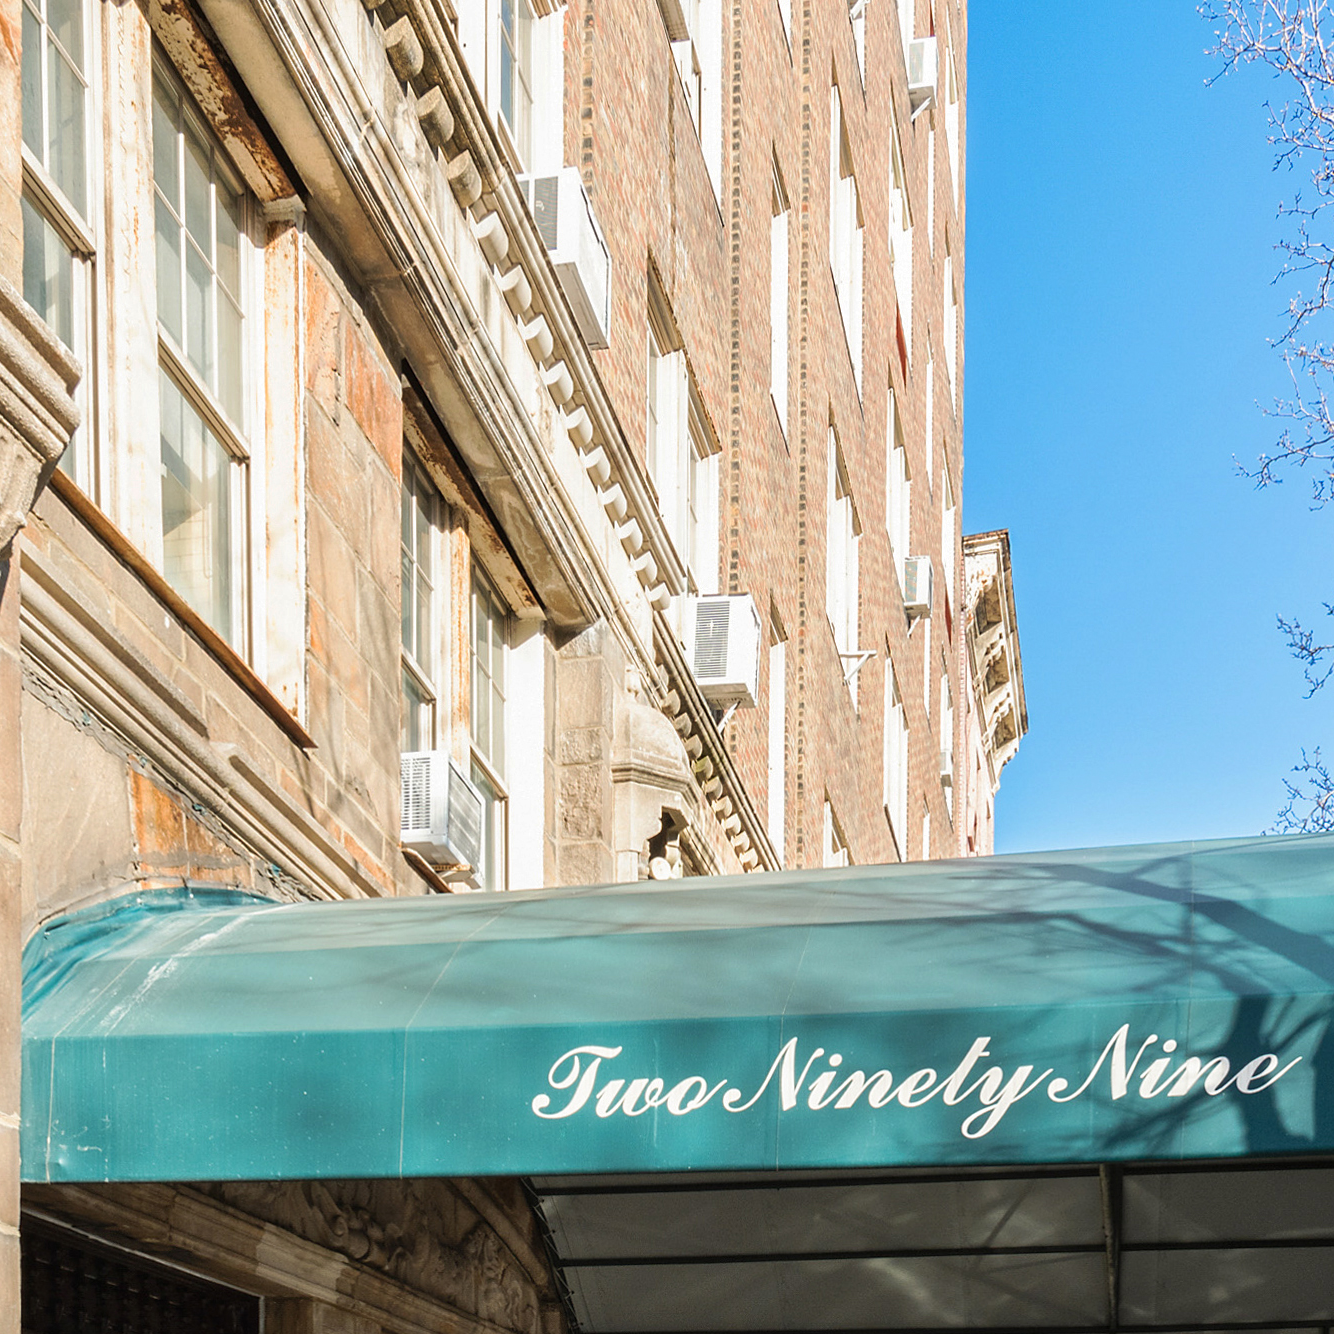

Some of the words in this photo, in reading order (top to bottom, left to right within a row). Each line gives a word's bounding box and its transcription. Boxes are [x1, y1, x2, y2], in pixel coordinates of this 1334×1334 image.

[532, 1044, 728, 1120] Two
[723, 1036, 1054, 1140] Ninety
[1048, 1023, 1302, 1102] Nine
